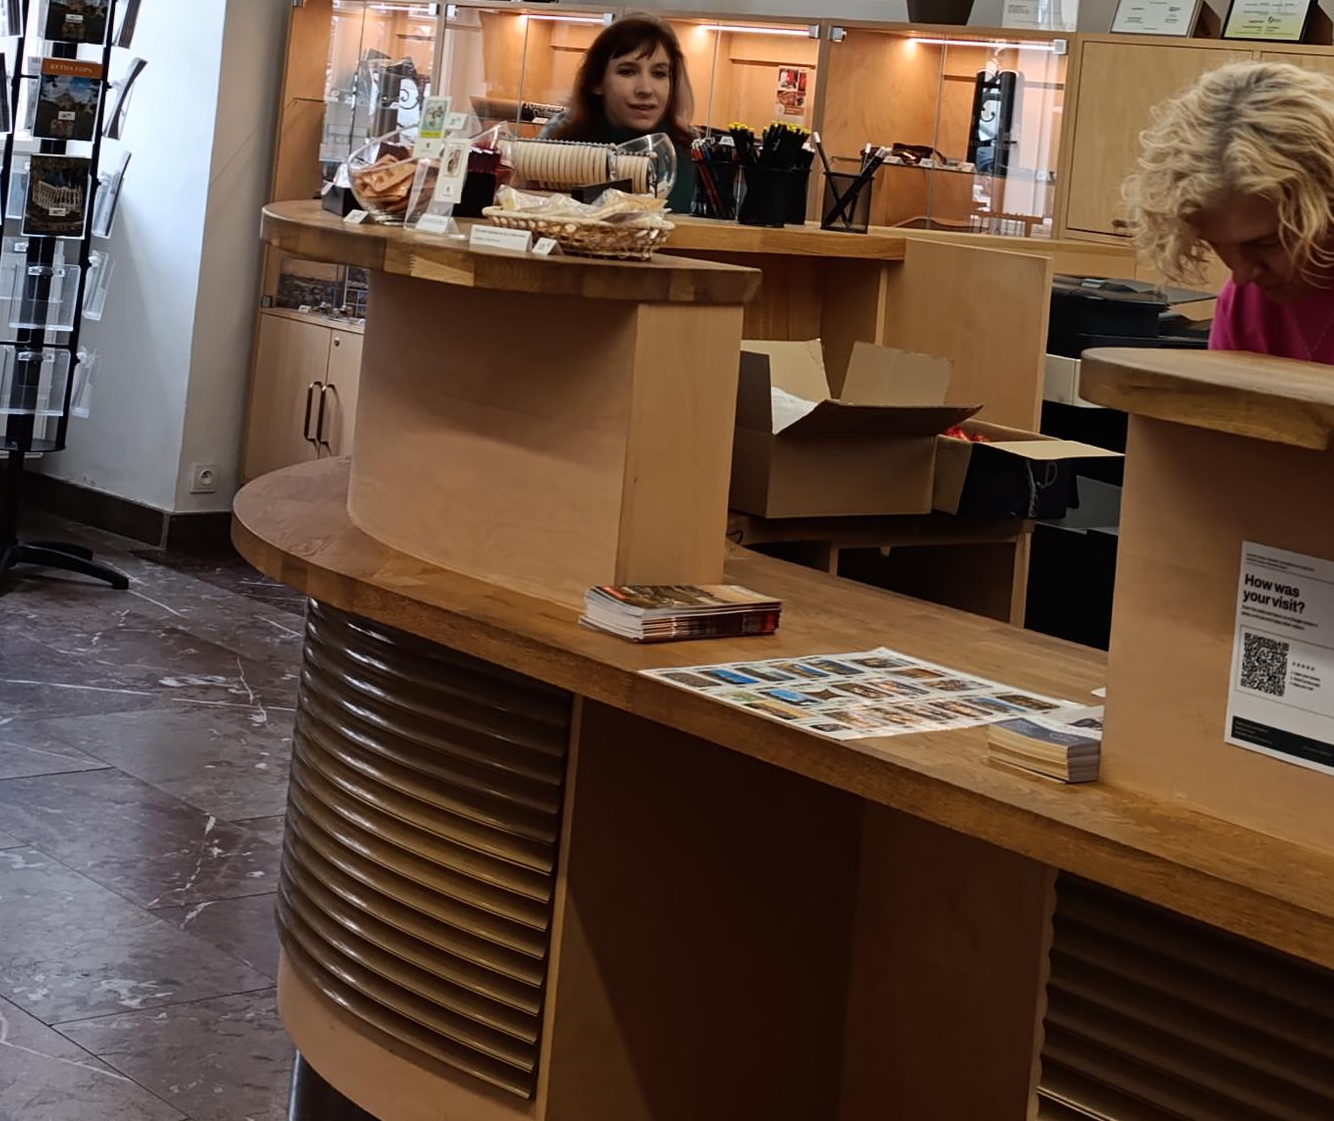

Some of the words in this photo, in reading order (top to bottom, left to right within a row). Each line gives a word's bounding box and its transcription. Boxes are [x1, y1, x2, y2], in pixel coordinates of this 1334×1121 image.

[1244, 574, 1272, 591] How
[1274, 582, 1300, 597] was
[1243, 589, 1273, 607] your
[1273, 596, 1306, 615] visit?
